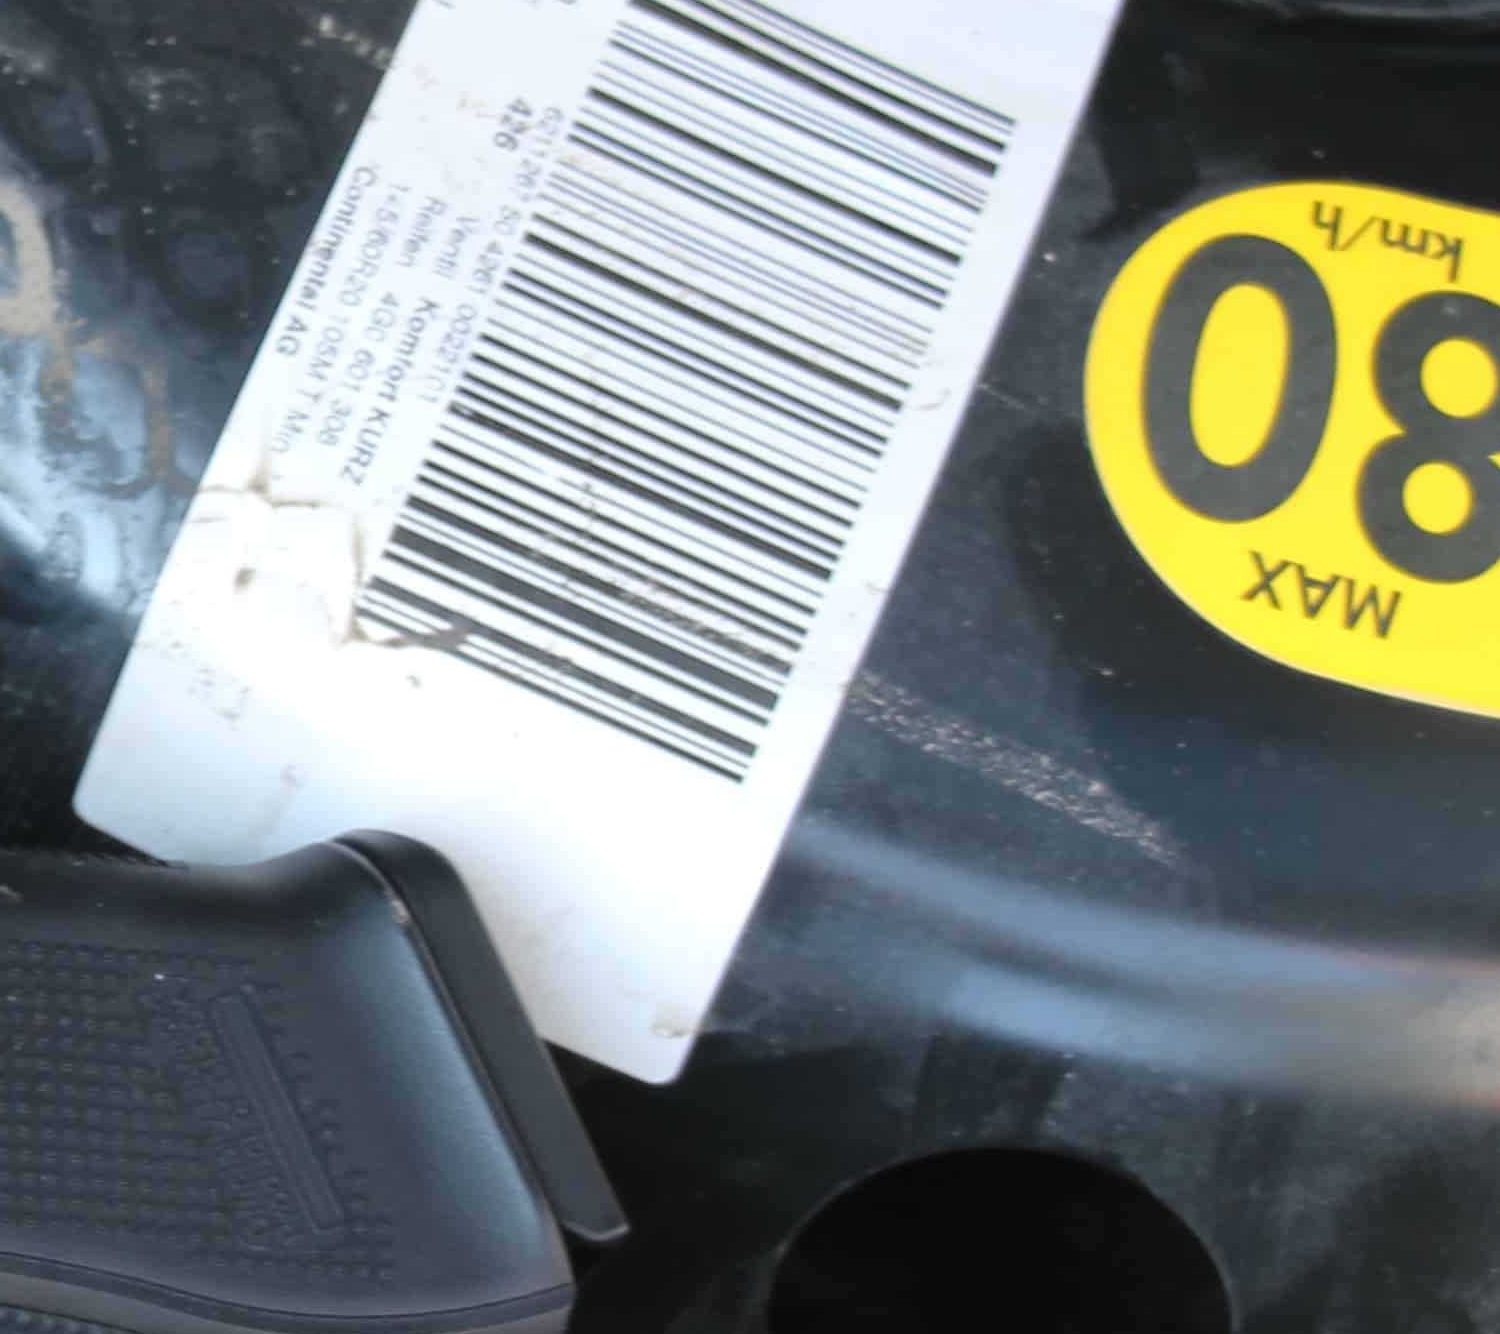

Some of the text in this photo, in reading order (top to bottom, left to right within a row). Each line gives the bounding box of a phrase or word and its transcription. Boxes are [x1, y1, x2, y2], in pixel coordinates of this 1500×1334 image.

[488, 93, 536, 155] 426
[271, 162, 377, 361] Continental AG
[393, 193, 447, 273] Reifen
[1310, 199, 1465, 284] km/h
[336, 210, 479, 488] Ventil Komfort KURZ
[1242, 550, 1402, 639] MAX
